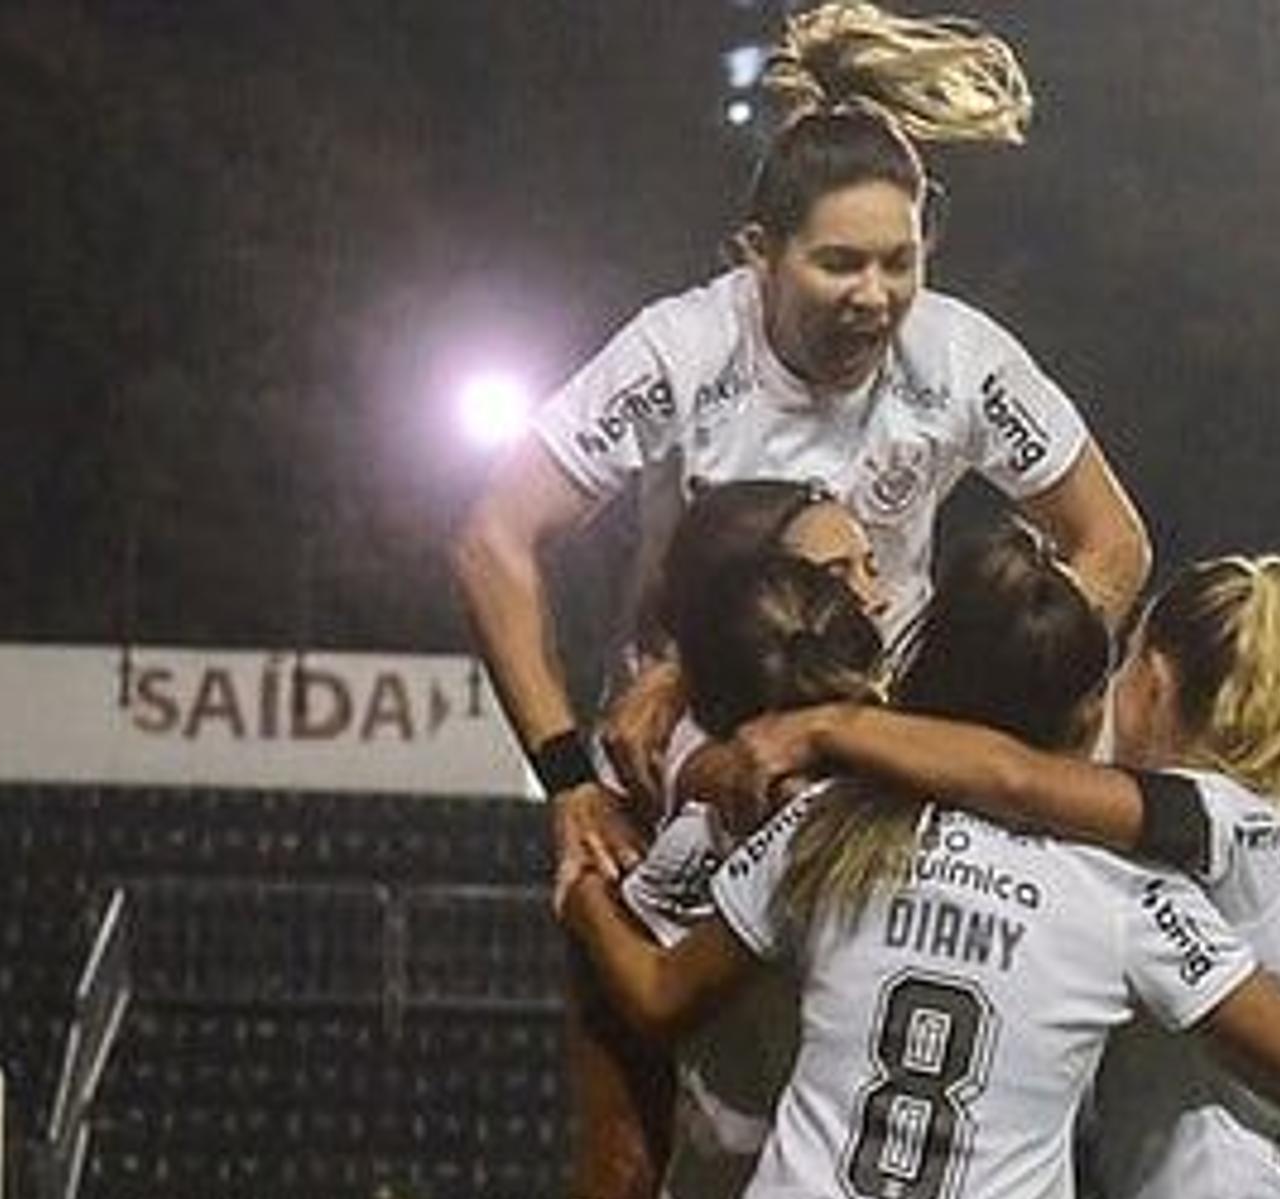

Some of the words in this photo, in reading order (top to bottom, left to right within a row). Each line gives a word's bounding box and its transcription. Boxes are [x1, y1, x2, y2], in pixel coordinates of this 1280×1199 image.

[131, 652, 416, 740] SAÍDA
[886, 897, 1027, 972] DIANY
[1154, 899, 1214, 986] bmg
